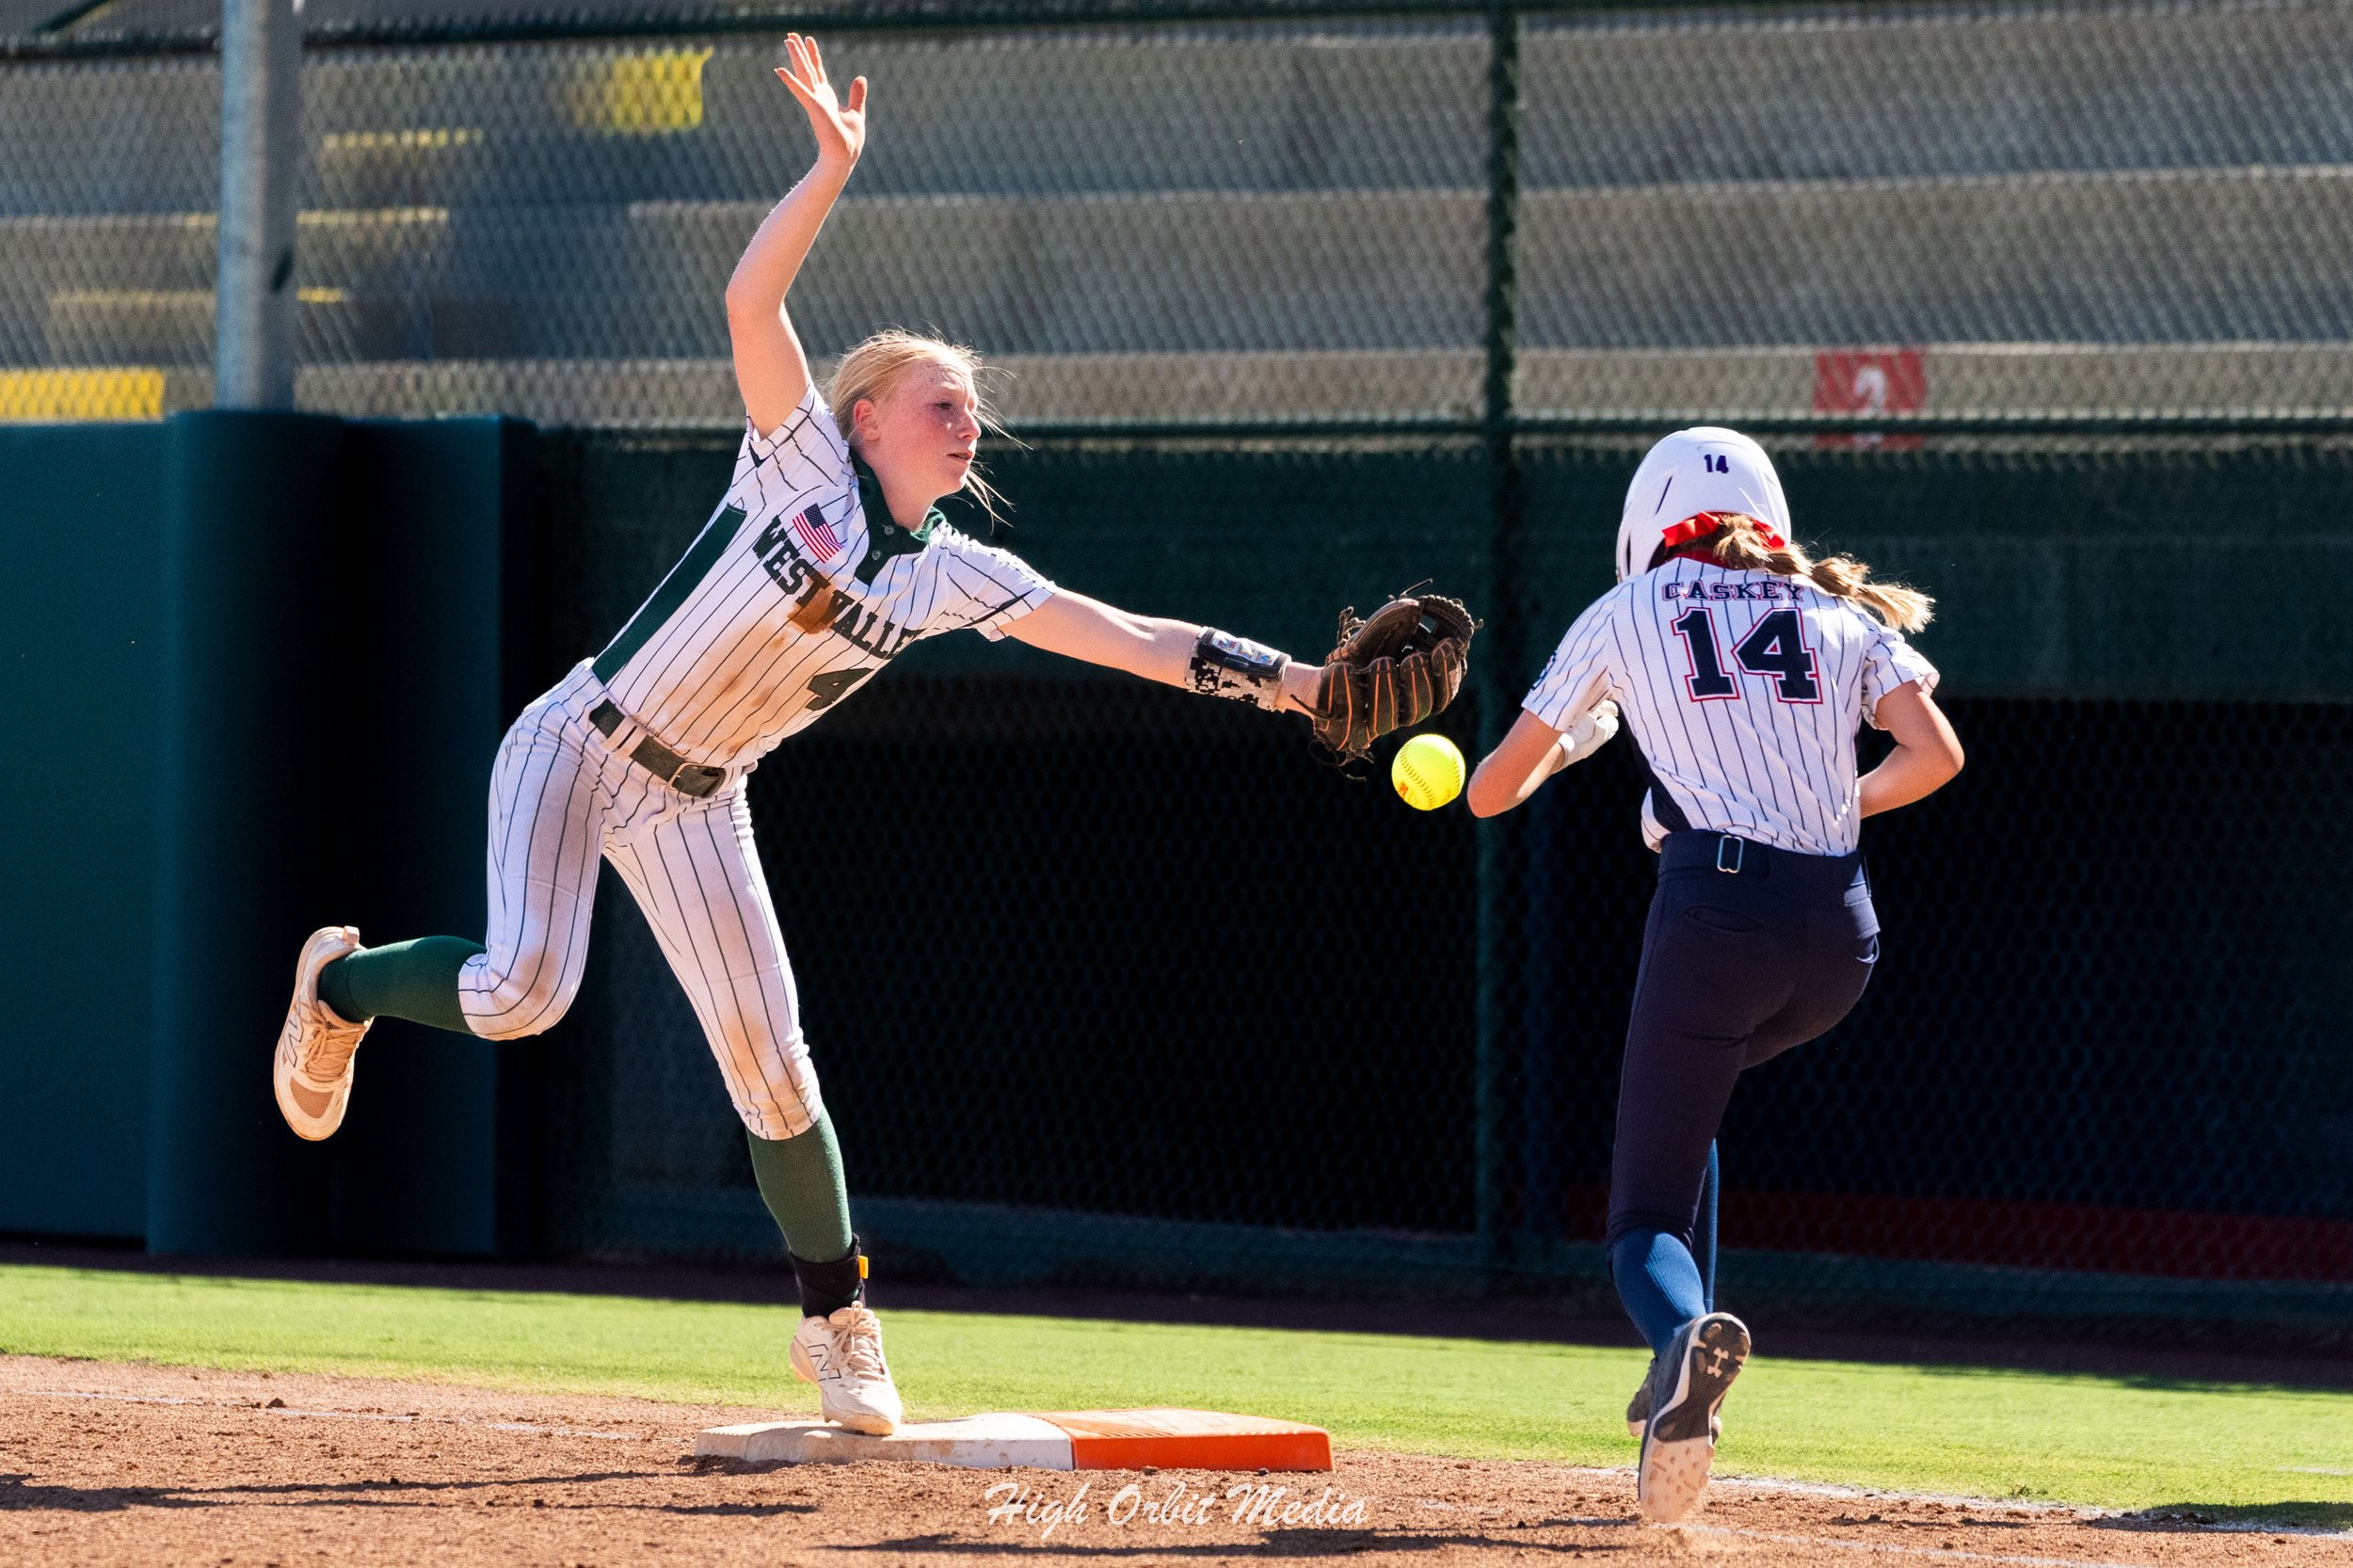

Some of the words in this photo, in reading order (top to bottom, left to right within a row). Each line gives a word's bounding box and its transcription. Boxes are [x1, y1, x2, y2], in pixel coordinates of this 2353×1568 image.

[1704, 454, 1729, 473] 14
[752, 514, 831, 608] WEST
[819, 589, 927, 660] VALLE
[1661, 580, 1804, 601] CASKEY
[1671, 607, 1823, 704] 14
[806, 667, 874, 711] 4
